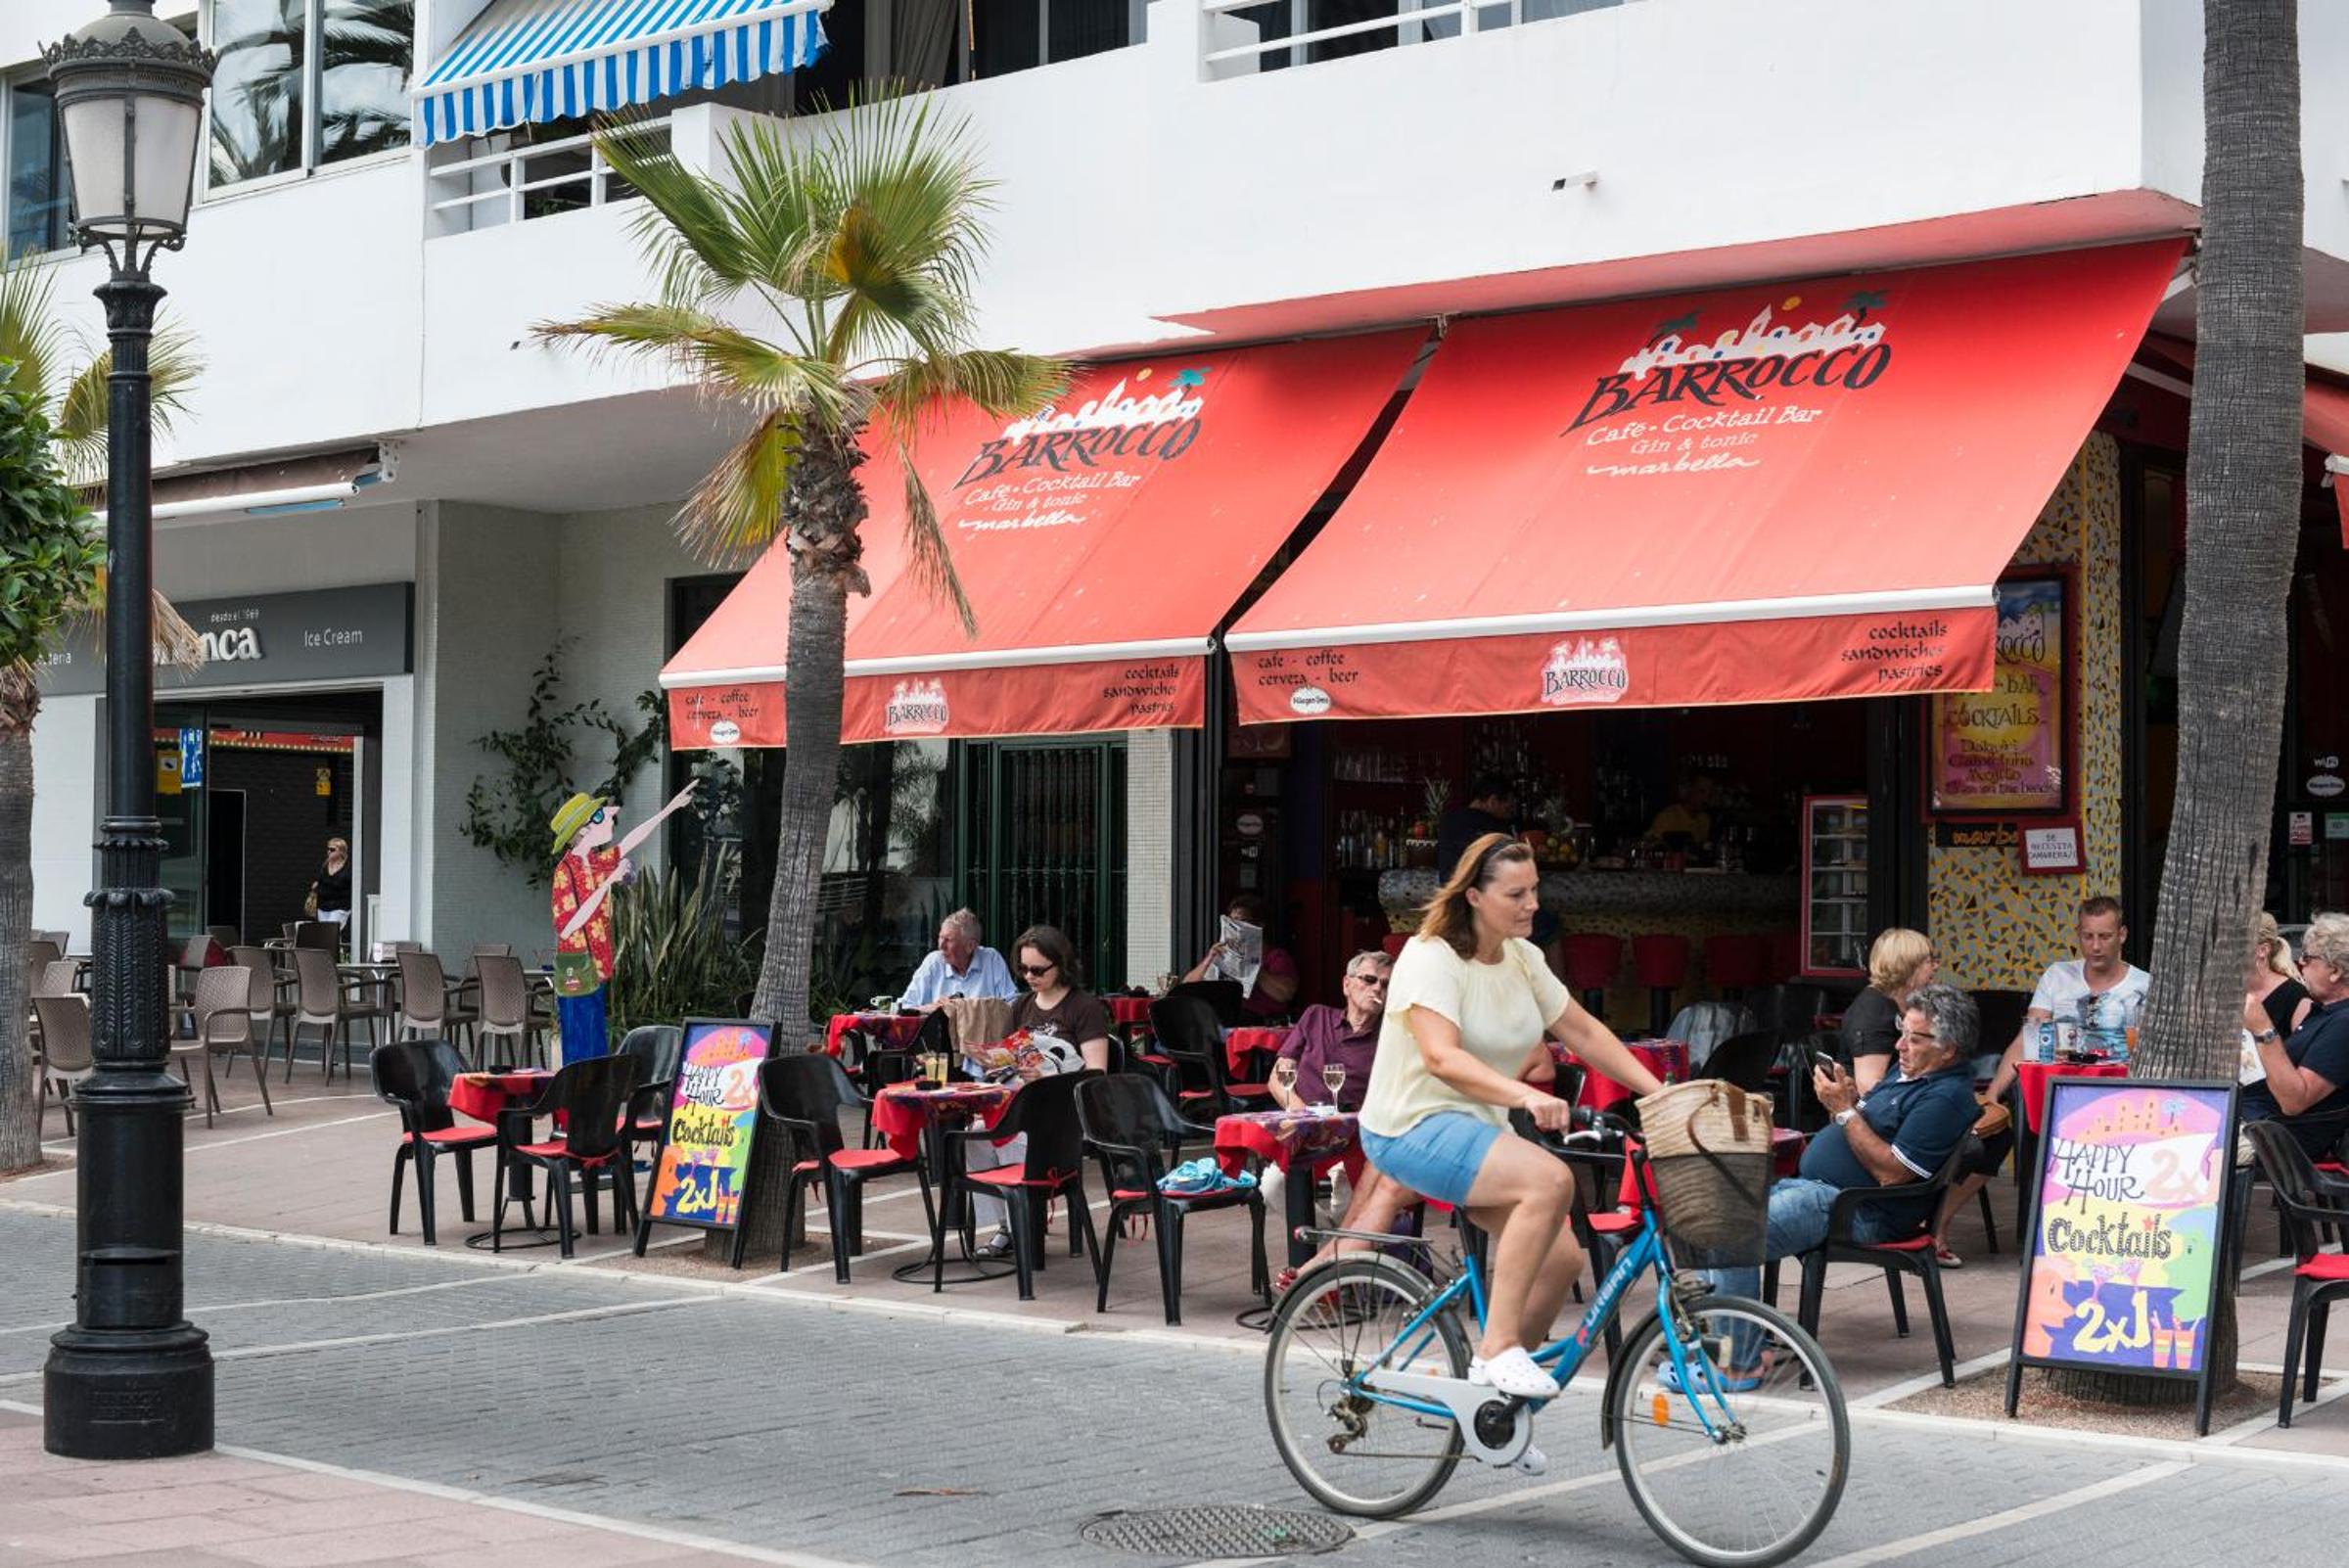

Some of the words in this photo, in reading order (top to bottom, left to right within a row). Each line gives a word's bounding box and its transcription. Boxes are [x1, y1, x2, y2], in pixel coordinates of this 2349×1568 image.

[1559, 343, 1892, 438] BARROCCO
[1663, 406, 1775, 433] Cocktail
[1775, 405, 1823, 424] Bar
[952, 417, 1202, 490] BARROCCO
[1630, 439, 1670, 454] Gin
[1701, 432, 1759, 449] tonic
[1586, 452, 1761, 477] marbella
[1022, 472, 1106, 493] Cocktail
[1104, 471, 1142, 487] Bar
[304, 629, 321, 647] Ice
[323, 627, 363, 646] Cream
[1868, 620, 1948, 640] cocktails
[1306, 649, 1345, 667] coffee
[1996, 634, 2046, 666] OCCO
[1126, 664, 1179, 679] cocktails
[1259, 673, 1307, 686] cerveza
[1329, 668, 1359, 683] beer
[1544, 668, 1626, 695] BARROCCO
[720, 689, 750, 704] coffee
[738, 705, 759, 718] beer
[888, 704, 946, 726] BARROCCO
[1946, 702, 2041, 729] COCKTAILS
[681, 1063, 724, 1091] HAPPY
[684, 1083, 725, 1117] HOUR
[672, 1113, 736, 1147] Cocktails
[2047, 1137, 2137, 1180] HAPPY
[2063, 1167, 2145, 1216] HOUR
[2047, 1211, 2172, 1260] Cocktails
[1586, 1257, 1633, 1327] URBAN
